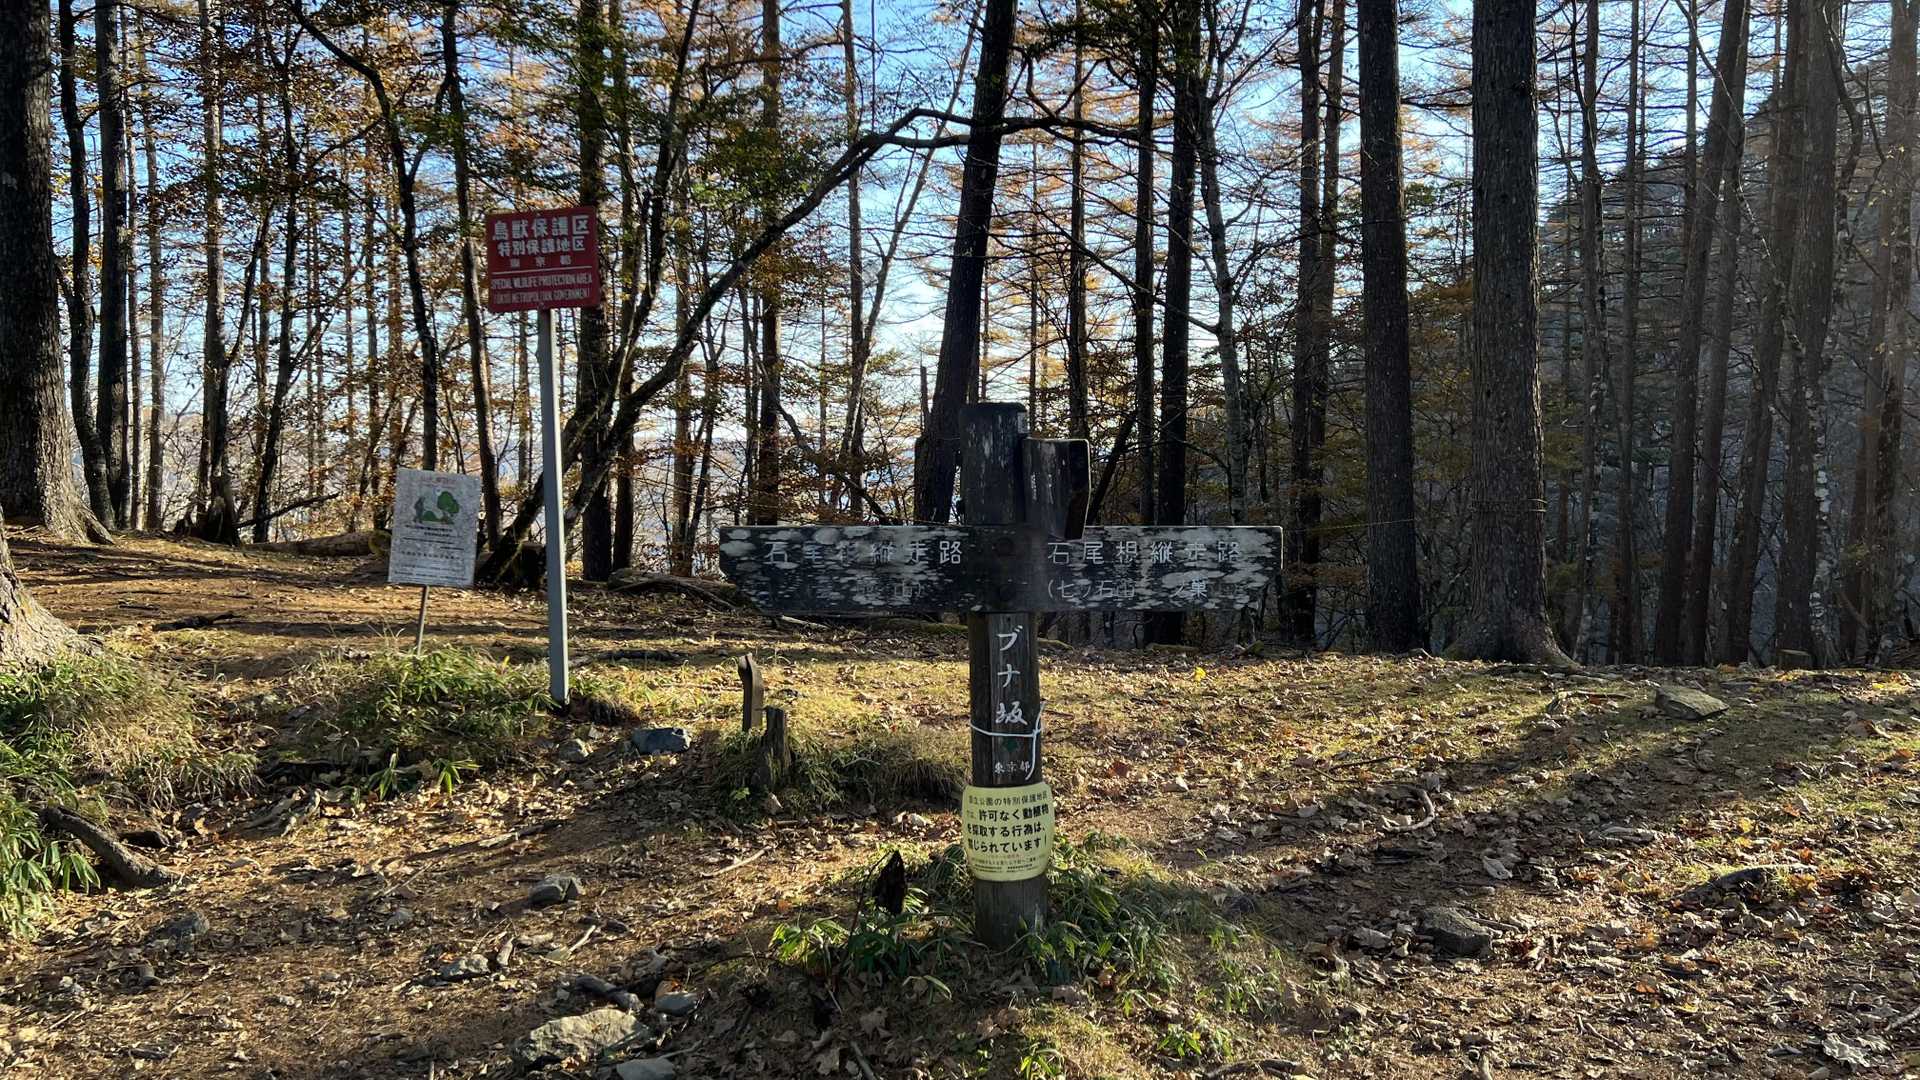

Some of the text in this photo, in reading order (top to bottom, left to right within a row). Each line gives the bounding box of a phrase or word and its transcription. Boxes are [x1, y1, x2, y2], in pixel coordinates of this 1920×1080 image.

[492, 215, 590, 240] 鳥獣保護区
[497, 236, 585, 257] 特別保護地区
[996, 624, 1028, 726] ブナ坂
